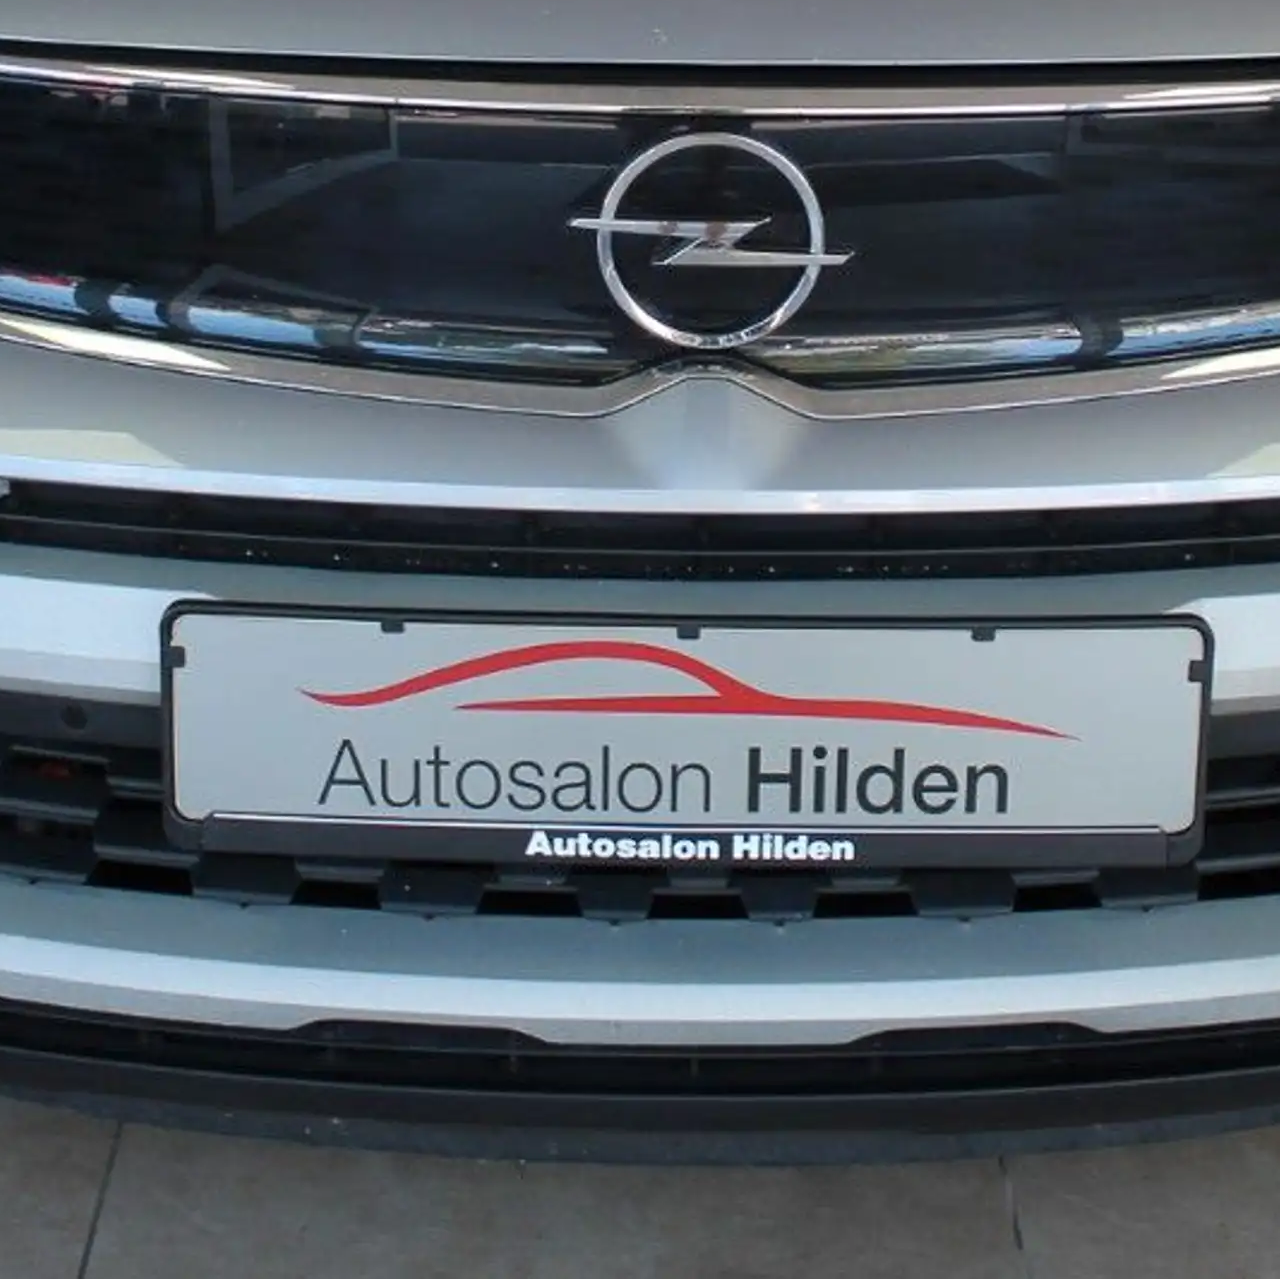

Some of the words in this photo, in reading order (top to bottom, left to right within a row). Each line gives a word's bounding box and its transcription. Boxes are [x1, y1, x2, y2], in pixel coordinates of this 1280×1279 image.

[317, 738, 712, 814] Autosalon
[747, 745, 1010, 815] Hilden
[524, 830, 720, 860] Autosalon
[732, 833, 855, 861] Hilden
